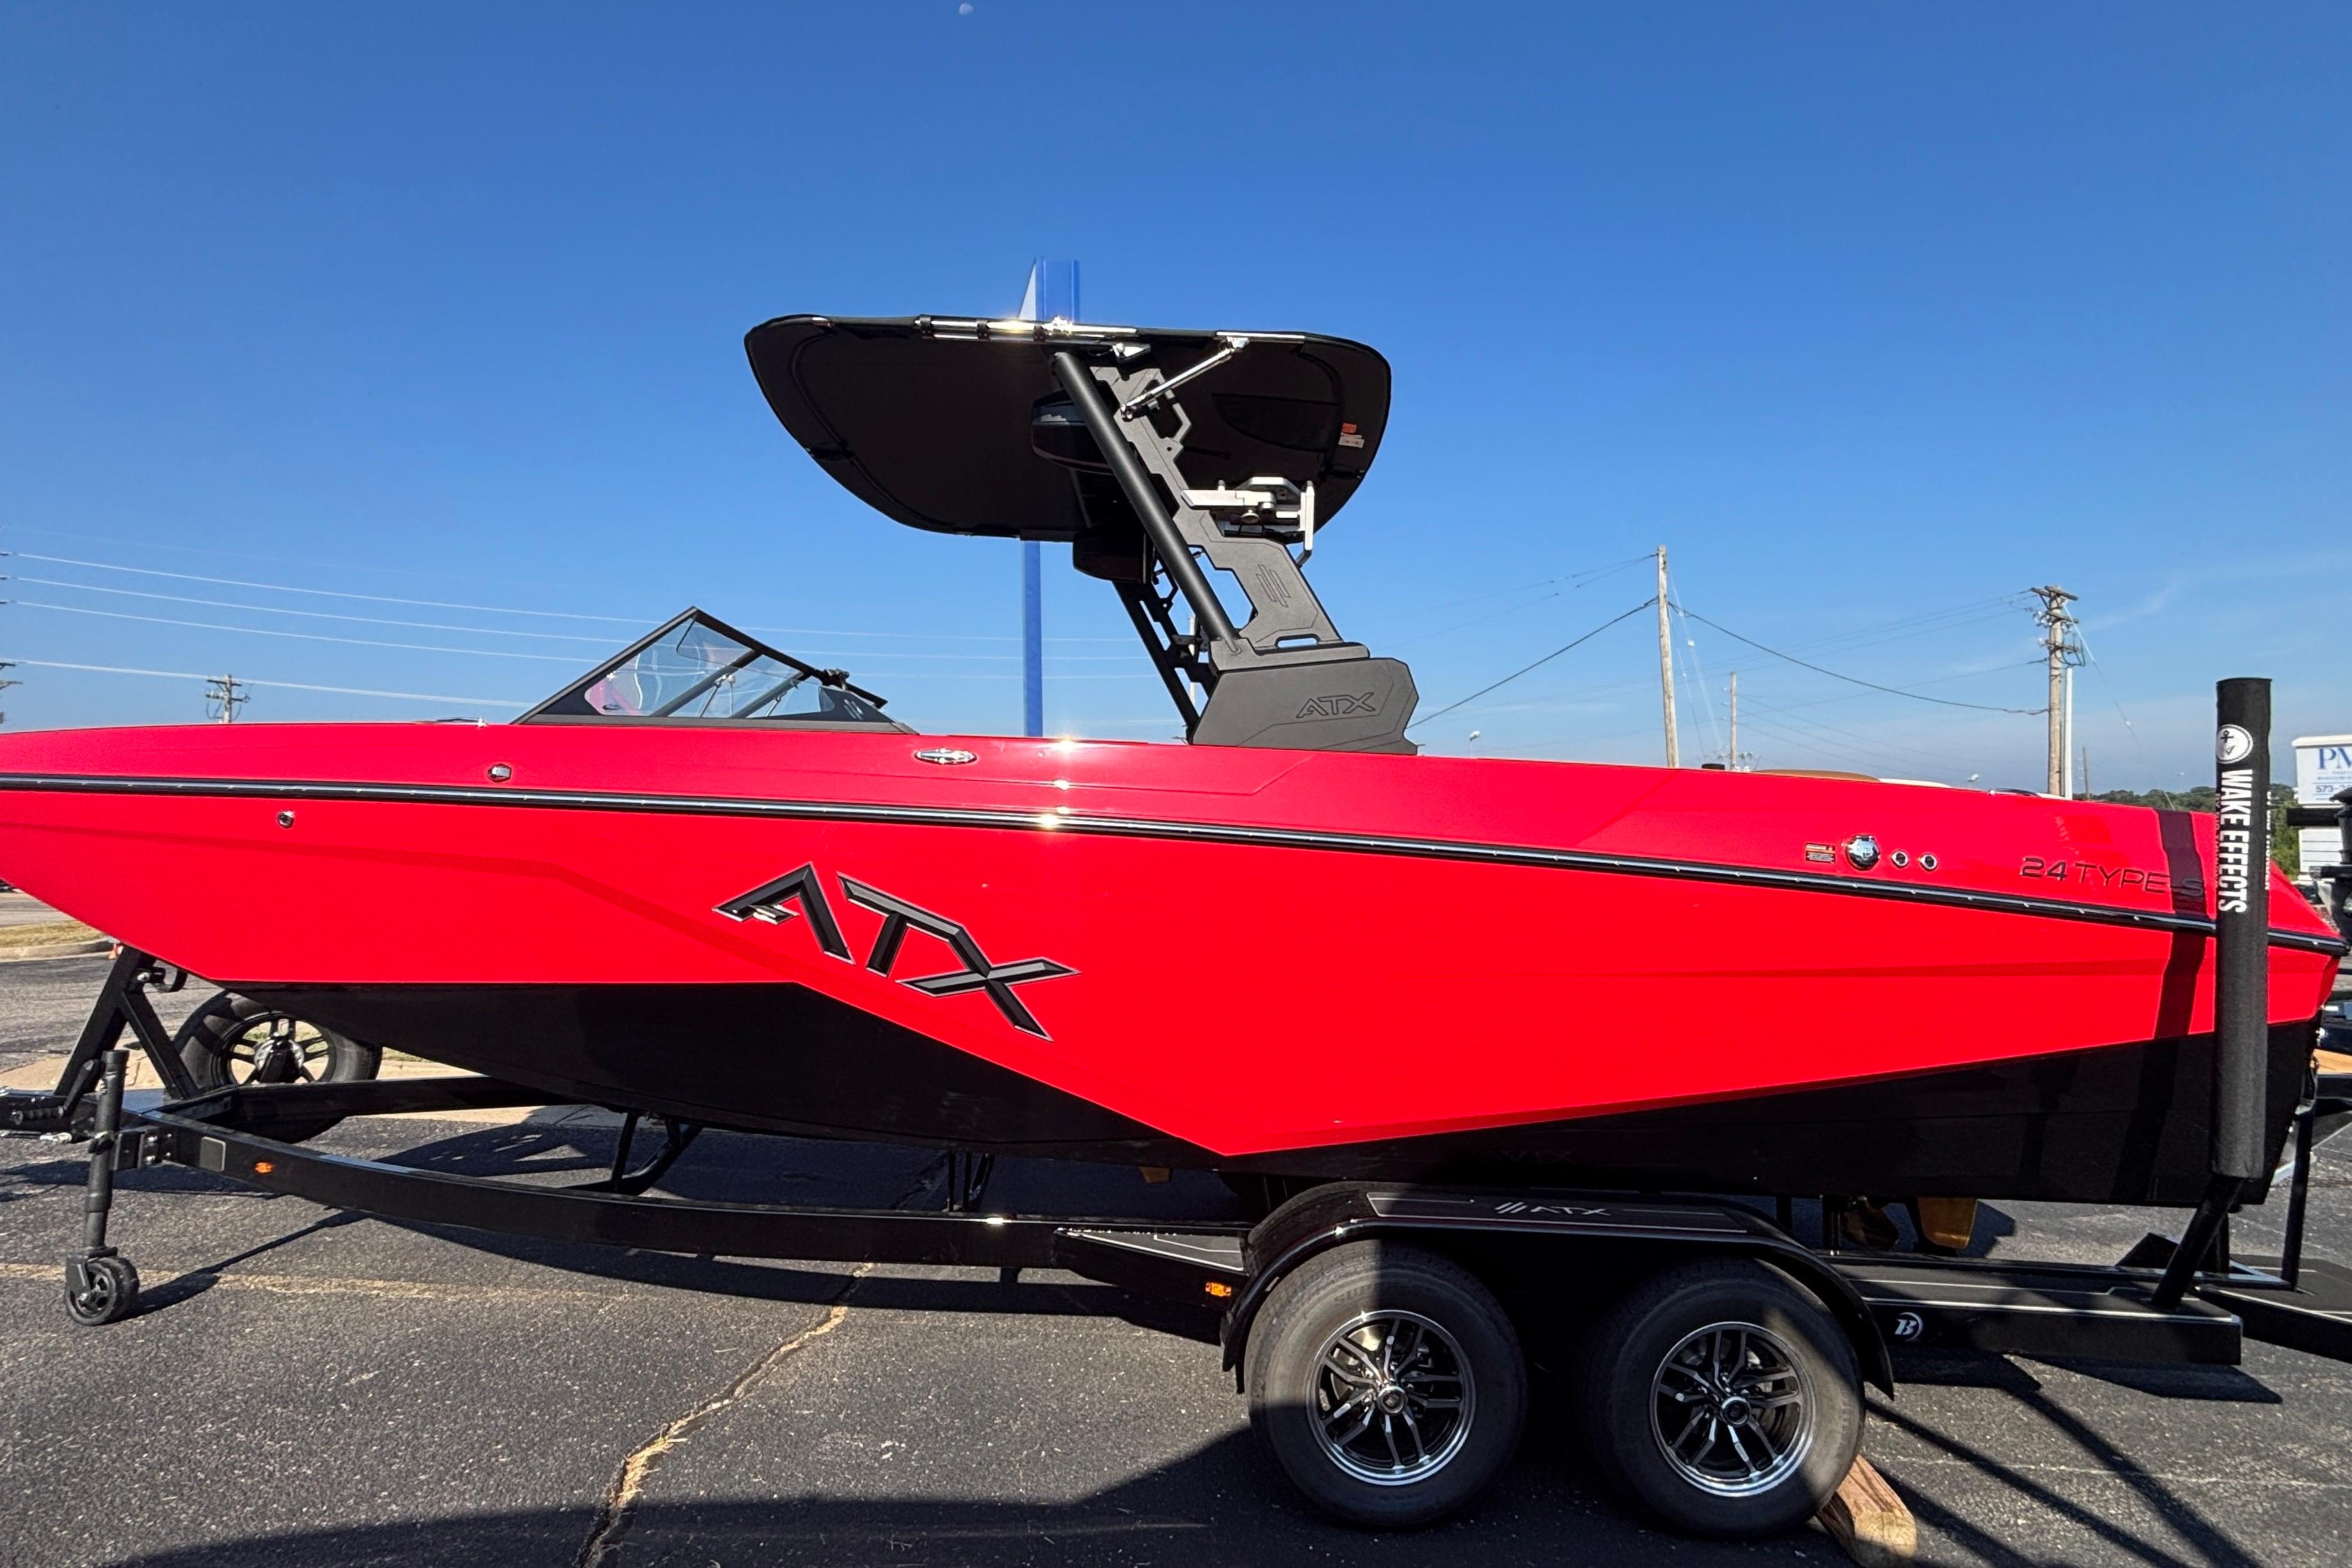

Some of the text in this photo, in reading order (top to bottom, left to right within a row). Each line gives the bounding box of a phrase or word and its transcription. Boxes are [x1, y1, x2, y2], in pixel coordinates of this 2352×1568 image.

[1296, 692, 1376, 718] ATX
[2217, 769, 2253, 913] WAKE EFFECTS
[2019, 857, 2069, 881] 24
[711, 861, 1082, 1043] ATX
[1529, 1206, 1612, 1217] ATX
